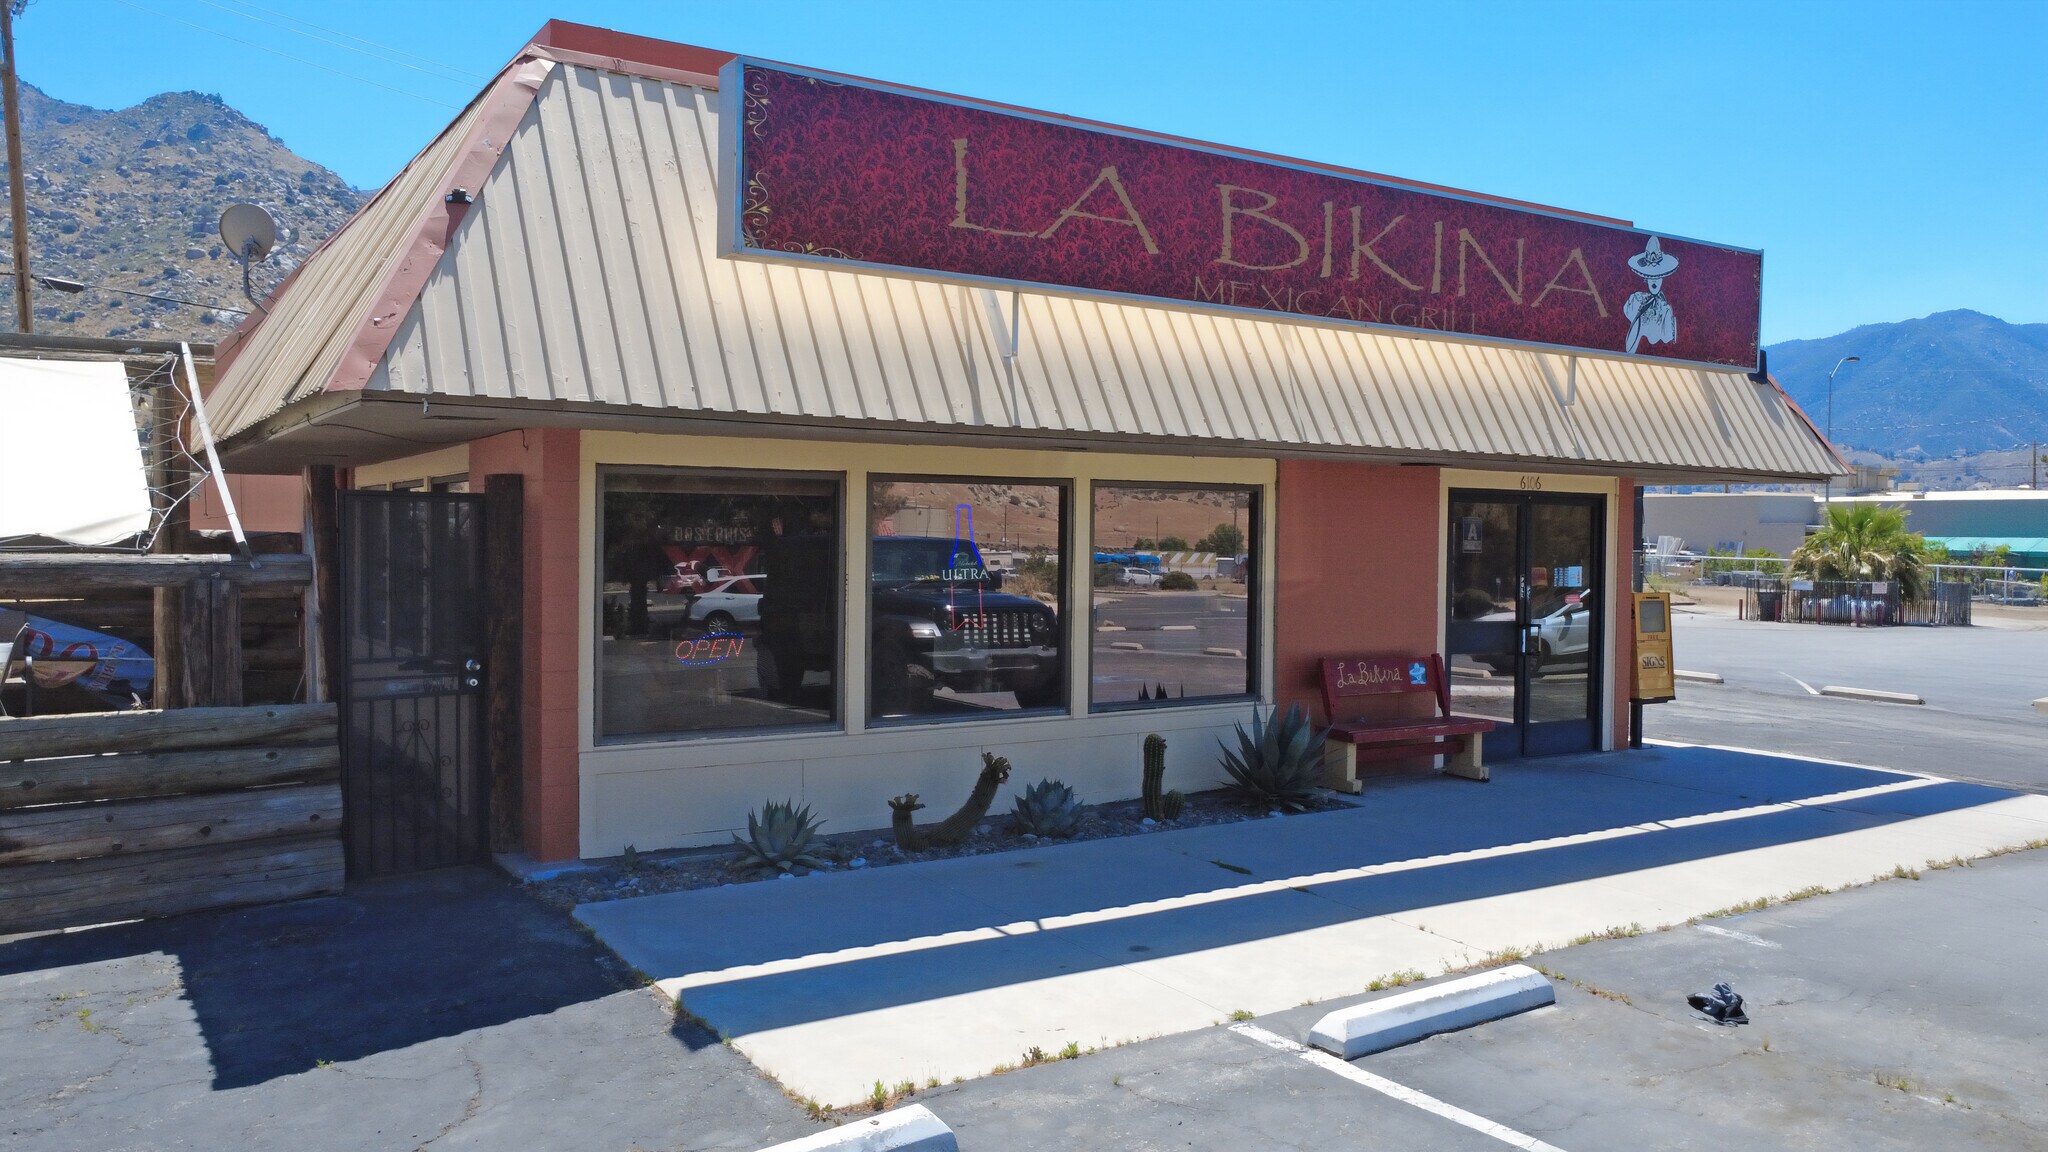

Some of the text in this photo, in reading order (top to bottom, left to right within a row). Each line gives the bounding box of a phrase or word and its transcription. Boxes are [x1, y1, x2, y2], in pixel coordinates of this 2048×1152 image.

[949, 138, 1608, 318] LA BIKINA
[1194, 276, 1381, 322] MEXICAN
[1520, 475, 1541, 490] 6106
[1467, 523, 1478, 540] A
[942, 568, 991, 580] ULTRA
[675, 639, 744, 659] OPEN
[1337, 661, 1402, 688] La Bikina
